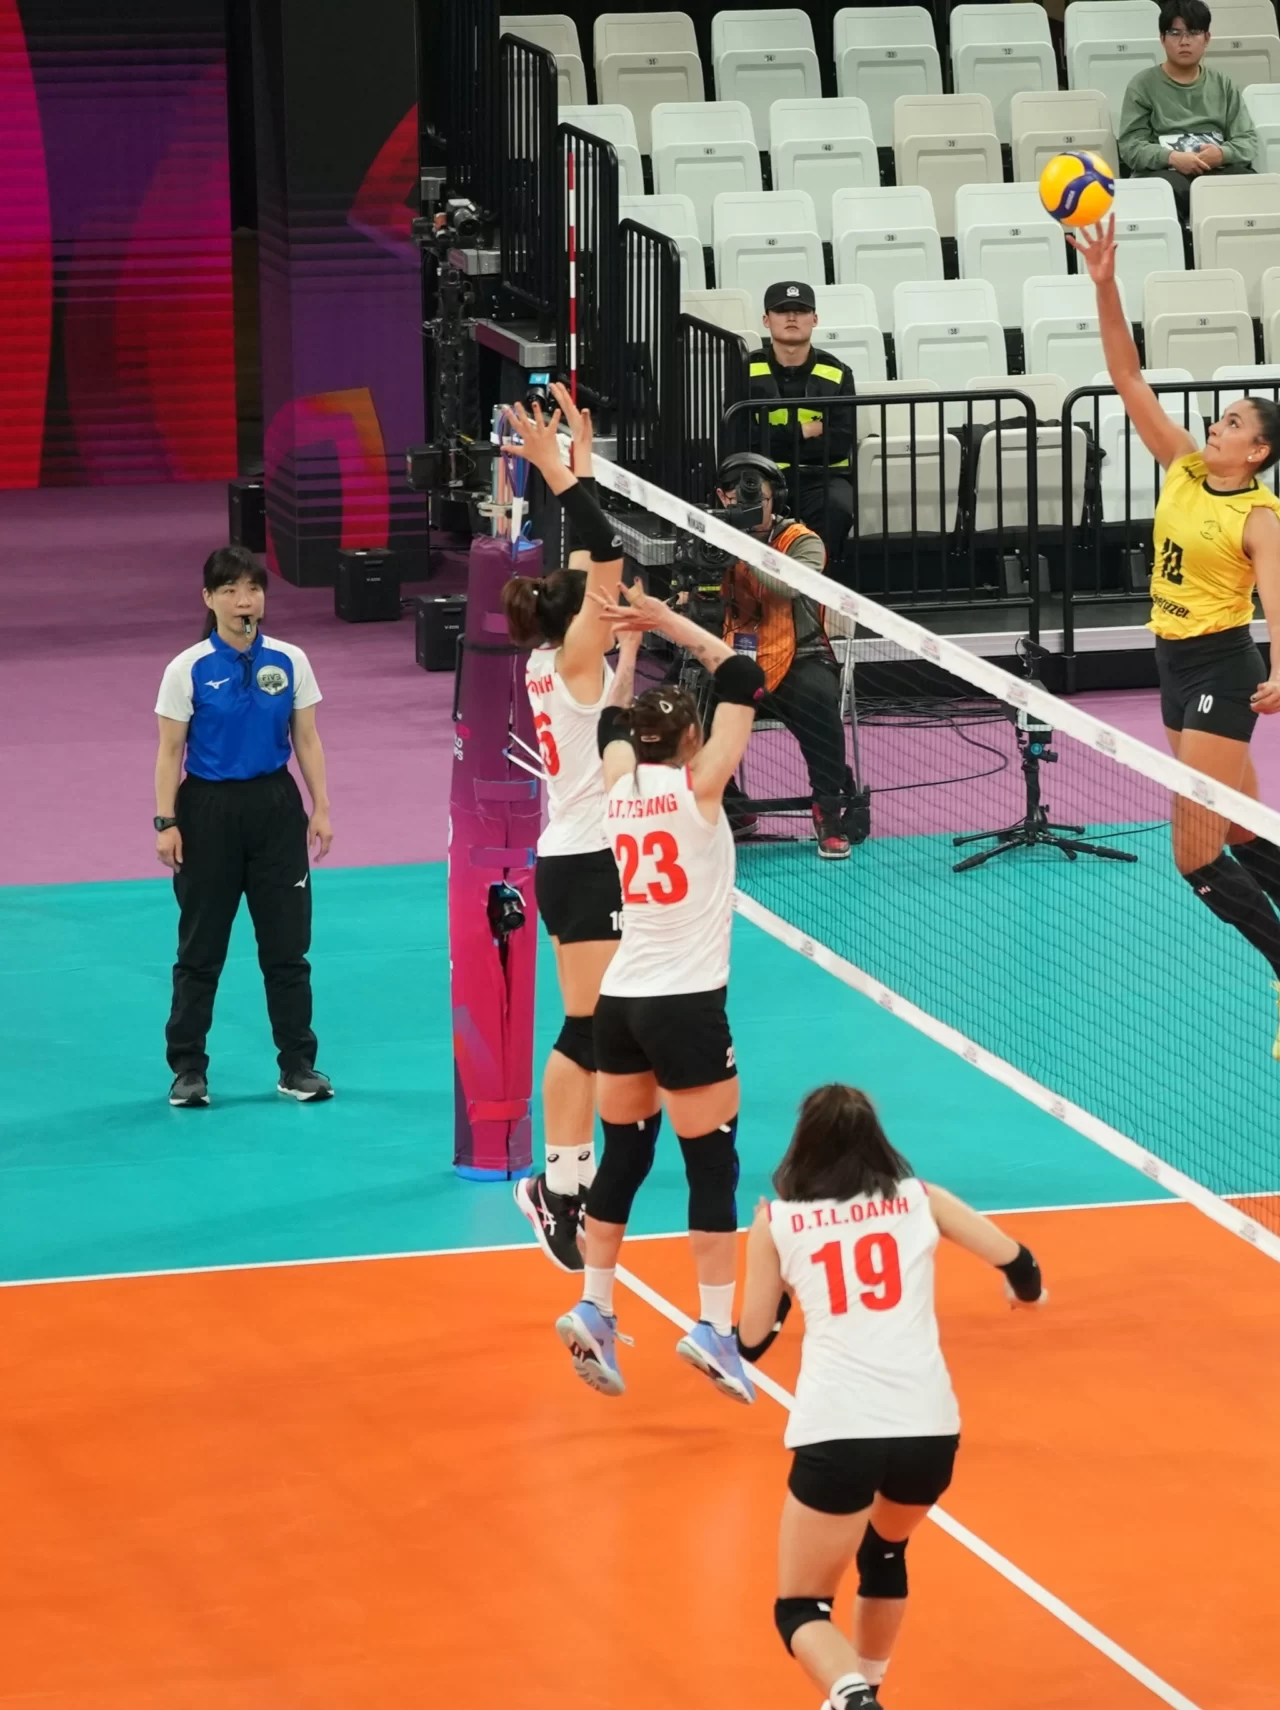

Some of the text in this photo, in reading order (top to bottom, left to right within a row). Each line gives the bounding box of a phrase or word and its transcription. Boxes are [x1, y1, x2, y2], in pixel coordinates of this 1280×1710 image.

[1197, 694, 1213, 713] 10
[615, 831, 688, 905] 23
[791, 1197, 909, 1233] D.T.L.OANH
[810, 1232, 902, 1316] 19
